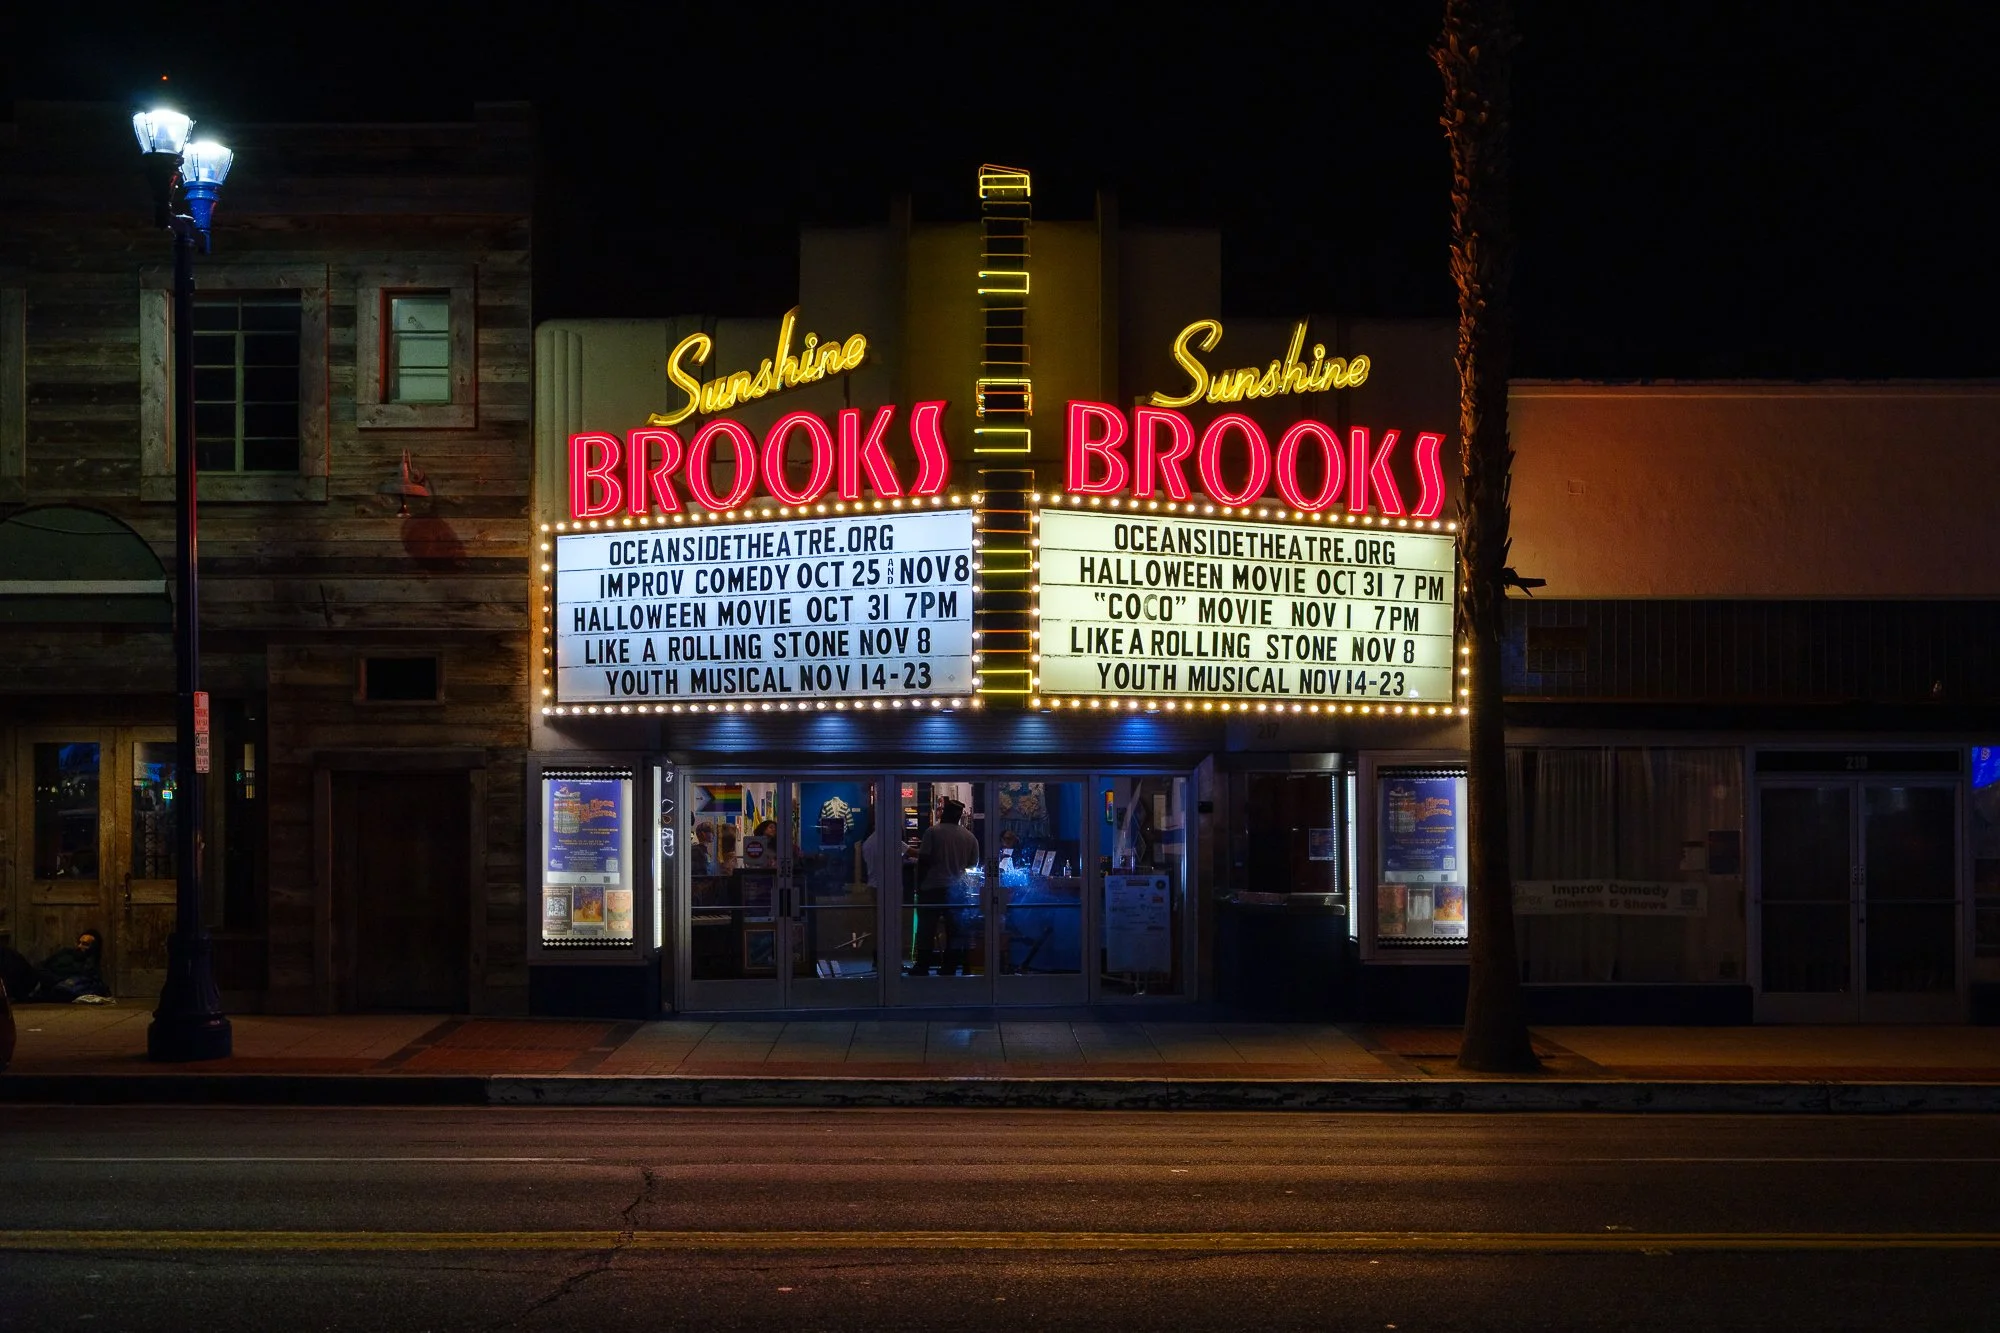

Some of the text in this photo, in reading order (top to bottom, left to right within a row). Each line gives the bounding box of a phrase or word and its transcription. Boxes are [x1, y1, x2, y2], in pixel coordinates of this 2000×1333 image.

[646, 304, 868, 427] Sunshine
[1149, 315, 1371, 408] Sunshine
[569, 400, 949, 519] BROOKS
[1066, 399, 1447, 520] BROOKS
[610, 525, 893, 565] OCEANSIDETHEATRE.ORG
[1115, 524, 1395, 565] OCEANSIDETHEATRE.ORG
[601, 570, 683, 598] IMPROV
[696, 564, 790, 594] COMEDY
[797, 561, 844, 588] OCT
[853, 559, 880, 586] 25
[901, 556, 950, 584] NOV
[1081, 557, 1222, 589] HALLOWEEN
[1233, 564, 1305, 593] MOVIE
[1317, 570, 1356, 595] OCT
[1364, 572, 1382, 596] 31
[575, 603, 705, 631] HALLOWEEN
[718, 598, 790, 626] MOVIE
[807, 596, 853, 622] OCT
[869, 594, 888, 620] 31
[1199, 598, 1272, 625] MOVIE
[1292, 602, 1336, 627] NOV
[586, 628, 930, 664] LIKE A ROLLING STONE NOV 8
[1072, 627, 1414, 663] LIKE A ROLLING STONE NOV 8
[605, 662, 931, 695] YOUTH MUSICAL NOV 14-23
[1097, 663, 1404, 696] YOUTH MUSICAL NOV 14-23
[1552, 883, 1604, 898] Improv
[1608, 883, 1670, 898] Comedy
